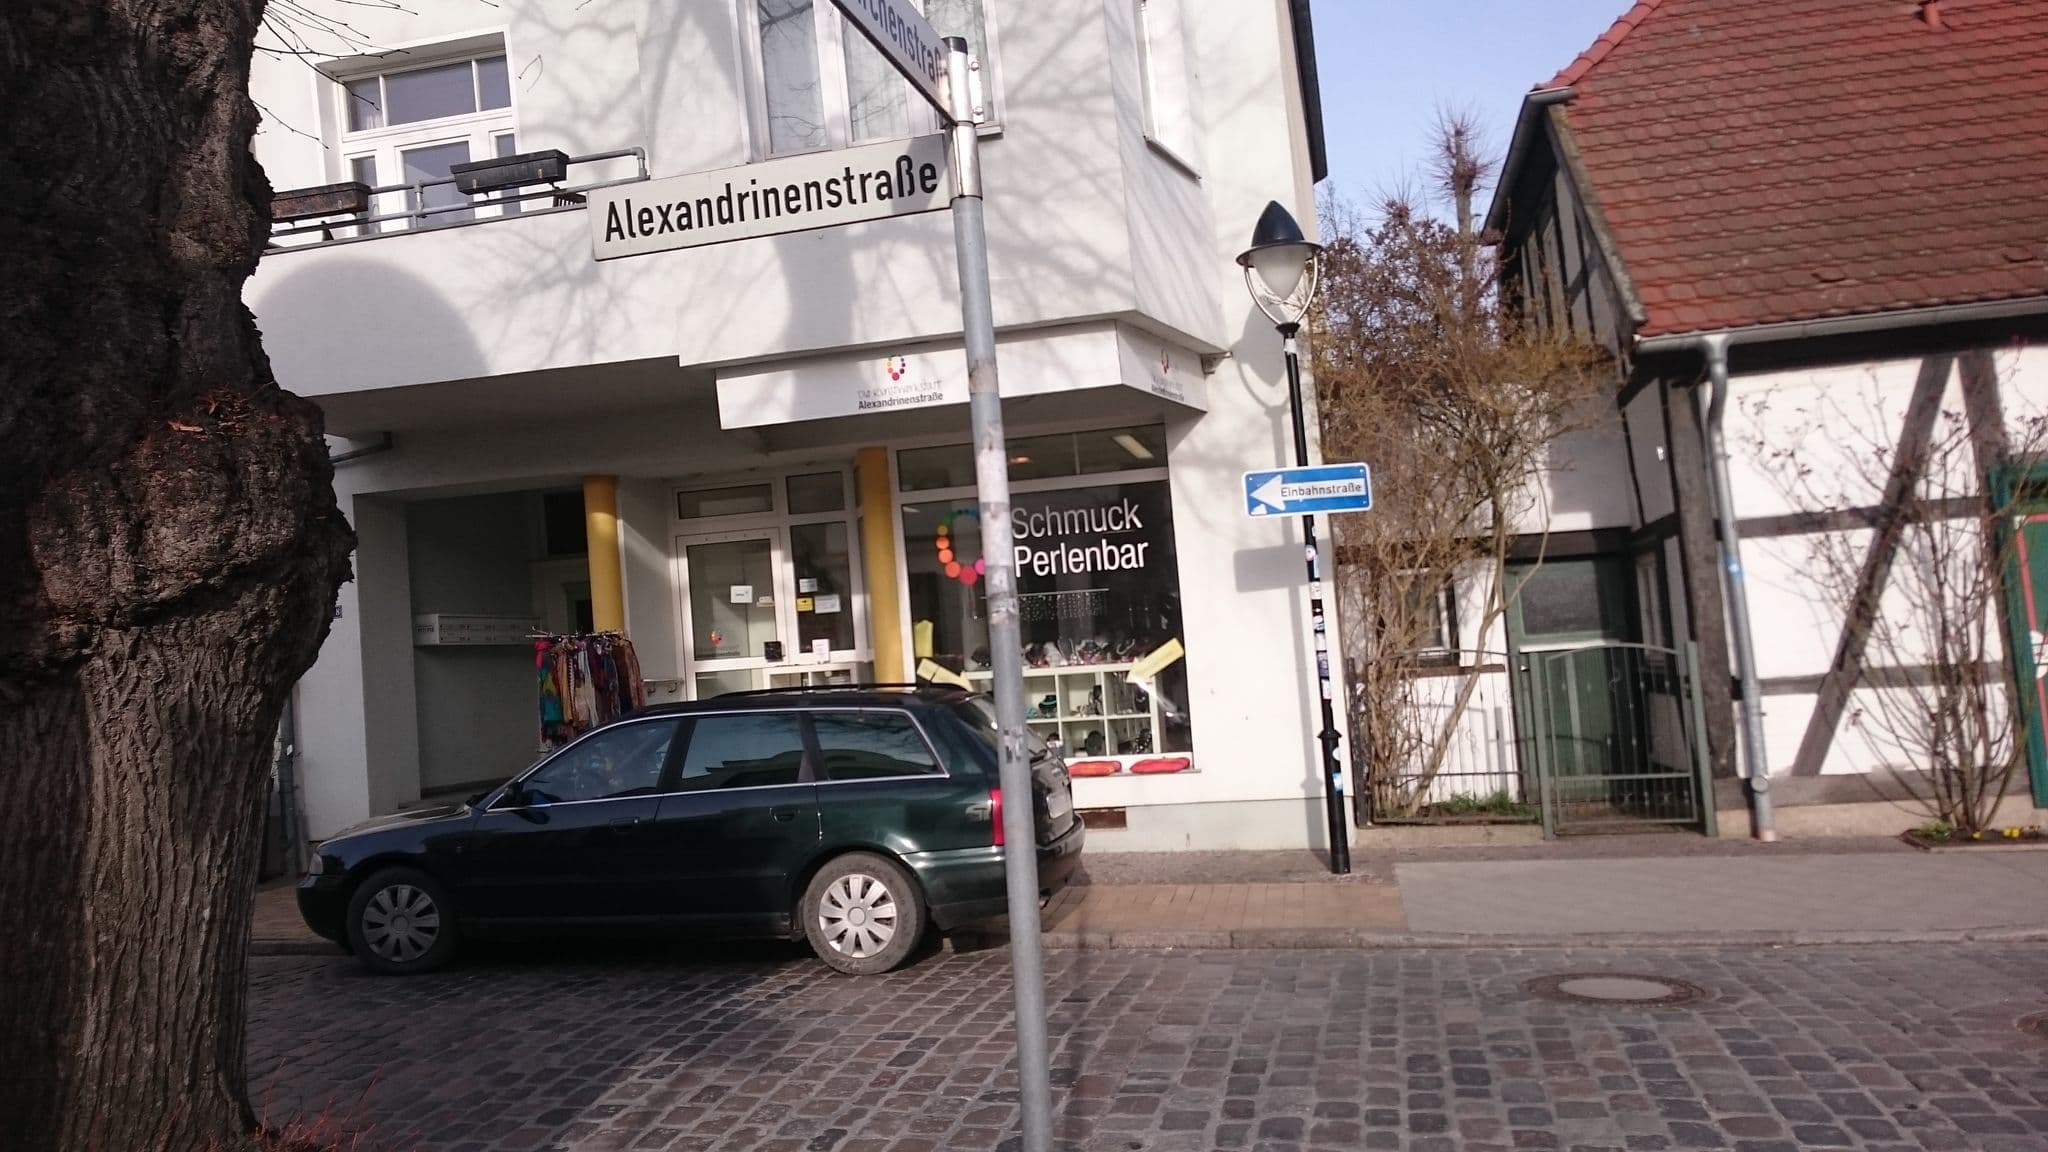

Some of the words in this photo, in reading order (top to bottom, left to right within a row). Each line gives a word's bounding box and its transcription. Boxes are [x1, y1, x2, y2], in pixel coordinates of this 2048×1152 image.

[605, 154, 939, 243] Alexandrinenstraße
[858, 392, 943, 410] Alexandrinenstraße
[1280, 482, 1362, 497] Einbahnstraße
[1012, 497, 1143, 539] Schmuck
[1014, 538, 1149, 577] Perlenbar
